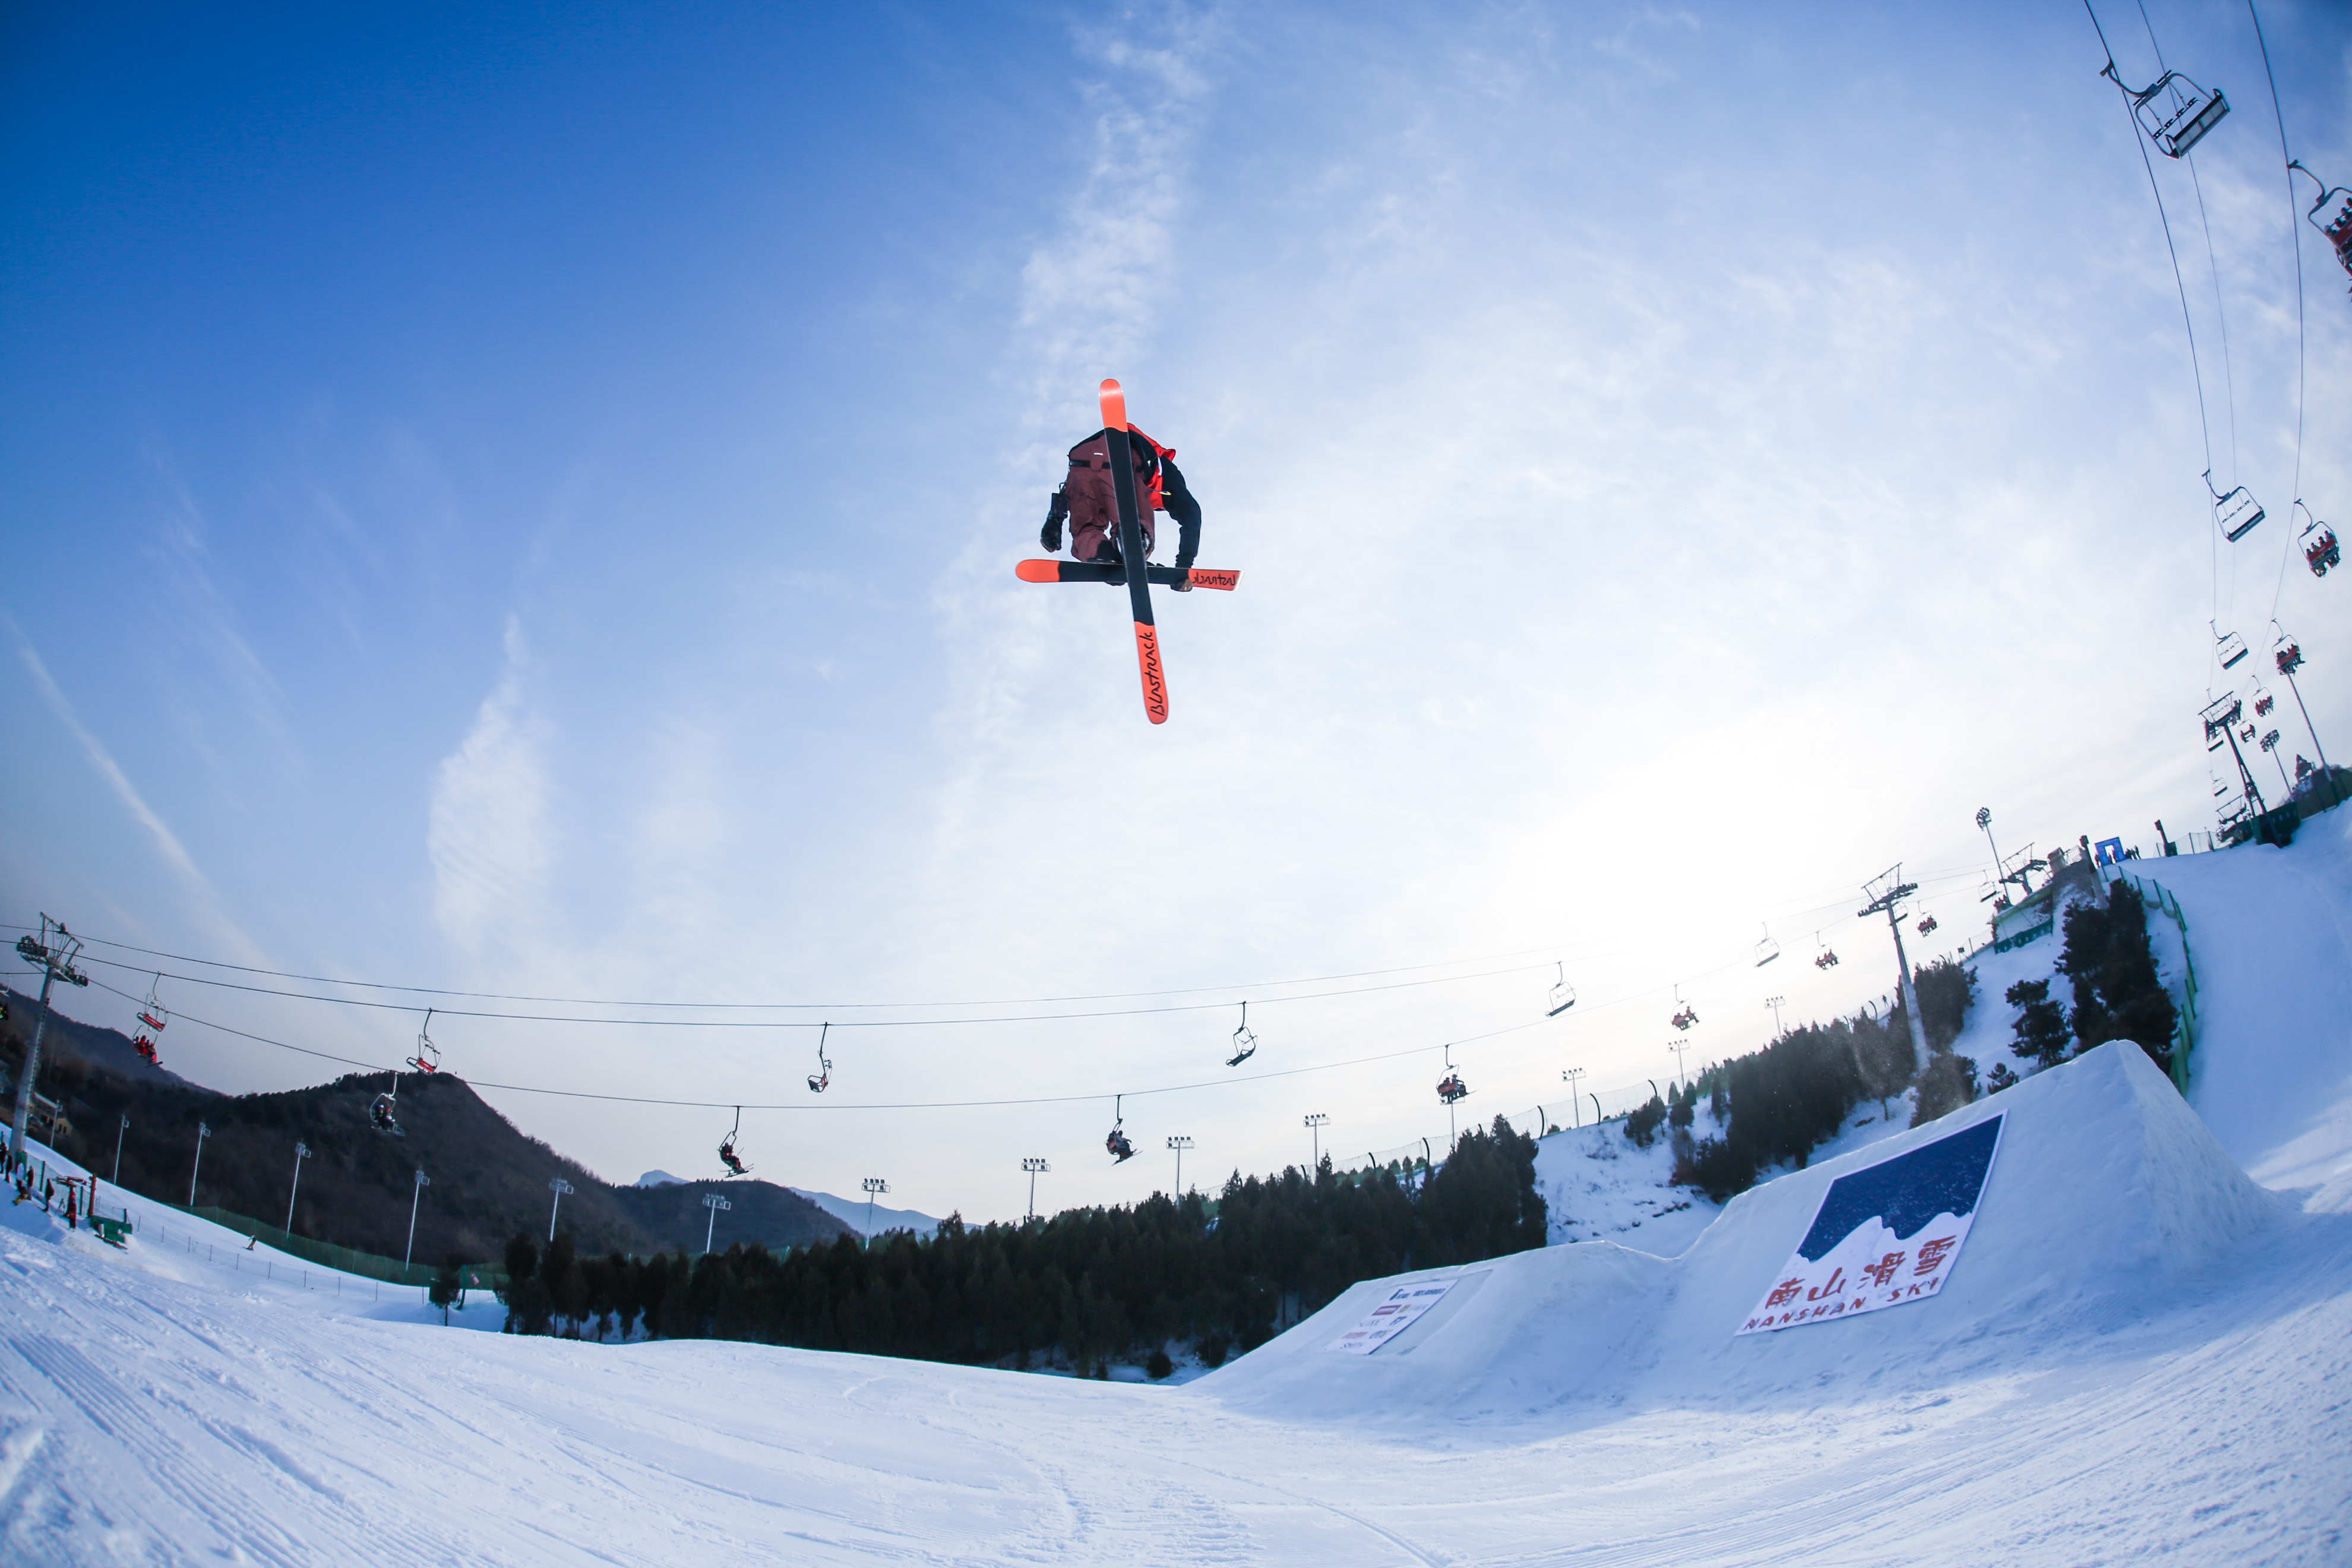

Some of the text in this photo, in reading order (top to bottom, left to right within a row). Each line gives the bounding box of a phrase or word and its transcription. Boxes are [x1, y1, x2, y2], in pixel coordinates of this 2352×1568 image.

[1743, 1277, 1940, 1331] NANSHAN SKI
[1765, 1234, 1958, 1310] 南山滑雪
